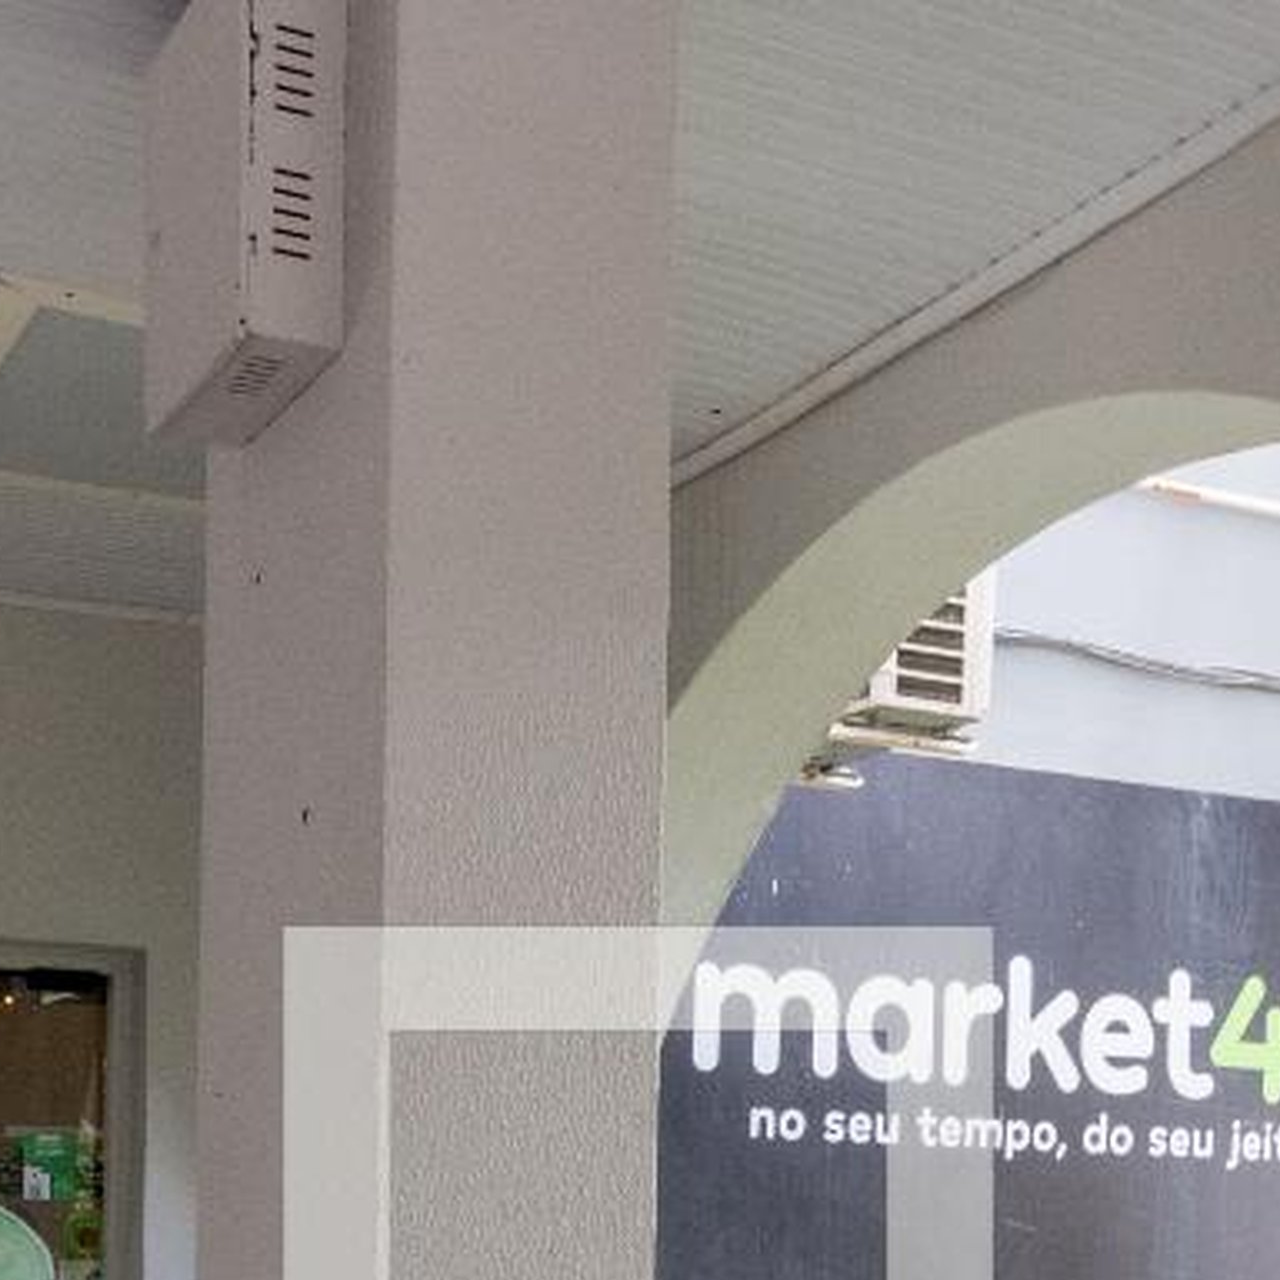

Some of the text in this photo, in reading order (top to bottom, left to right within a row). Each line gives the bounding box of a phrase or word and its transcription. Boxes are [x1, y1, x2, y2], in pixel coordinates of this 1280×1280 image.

[748, 1106, 808, 1143] no
[822, 1109, 901, 1146] seu
[916, 1106, 1069, 1161] tempo,
[1082, 1111, 1135, 1156] do
[1148, 1125, 1215, 1158] seu
